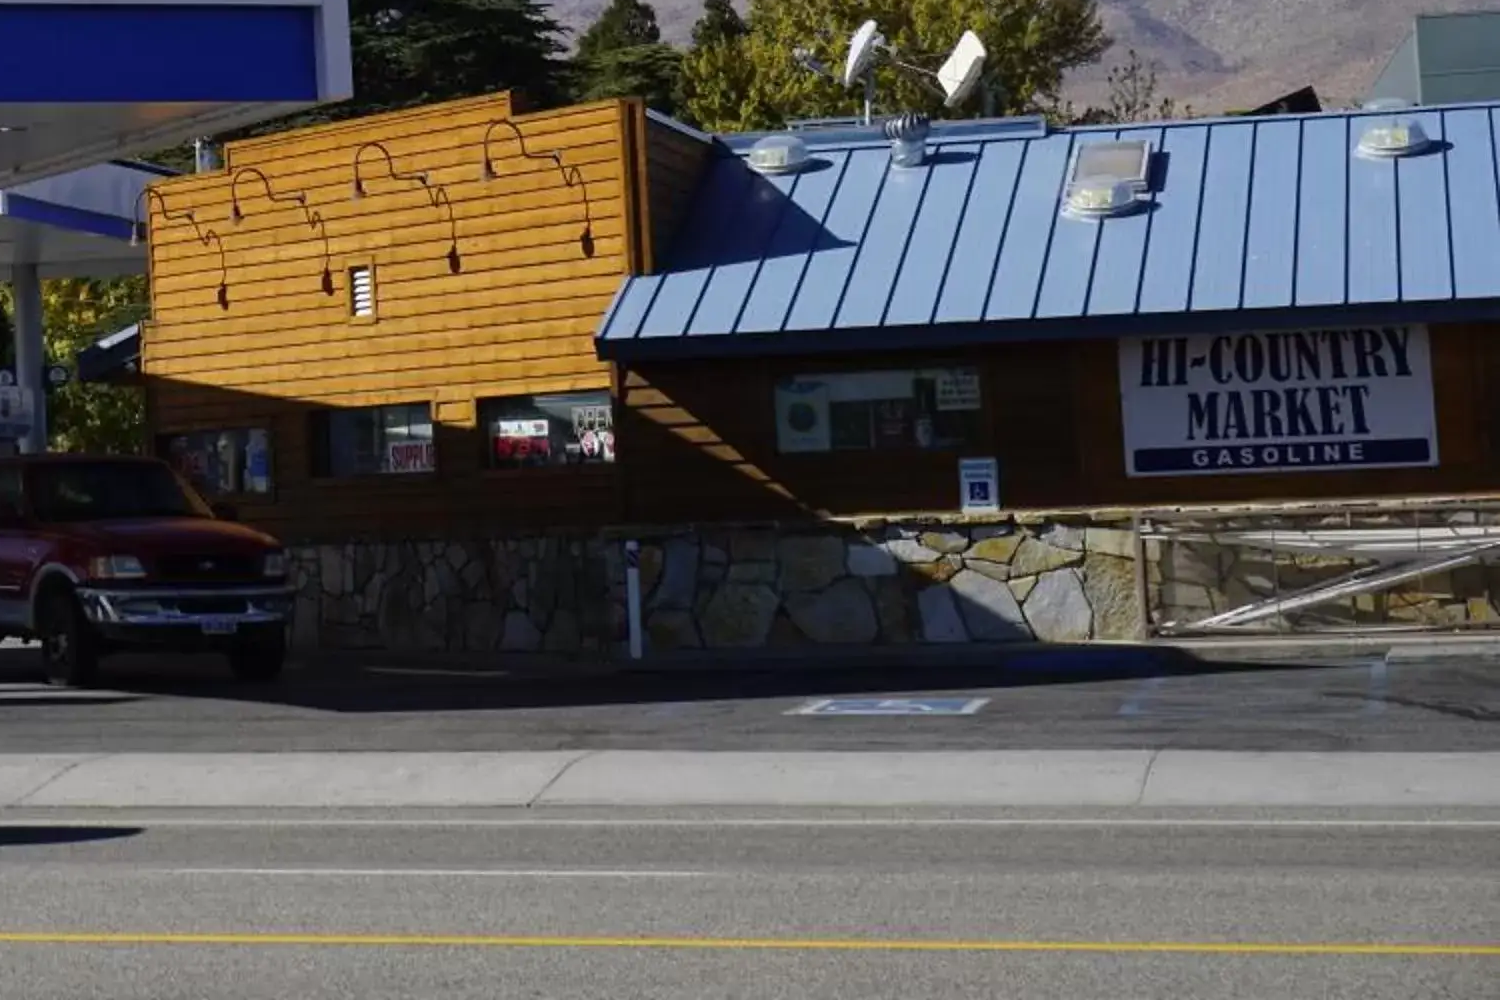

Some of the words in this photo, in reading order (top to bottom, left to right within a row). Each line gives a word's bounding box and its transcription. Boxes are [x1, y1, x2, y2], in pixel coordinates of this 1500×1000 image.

[1140, 327, 1413, 387] HI-COUNTRY
[1186, 385, 1371, 440] MARKET
[1191, 443, 1365, 466] GASOLINE
